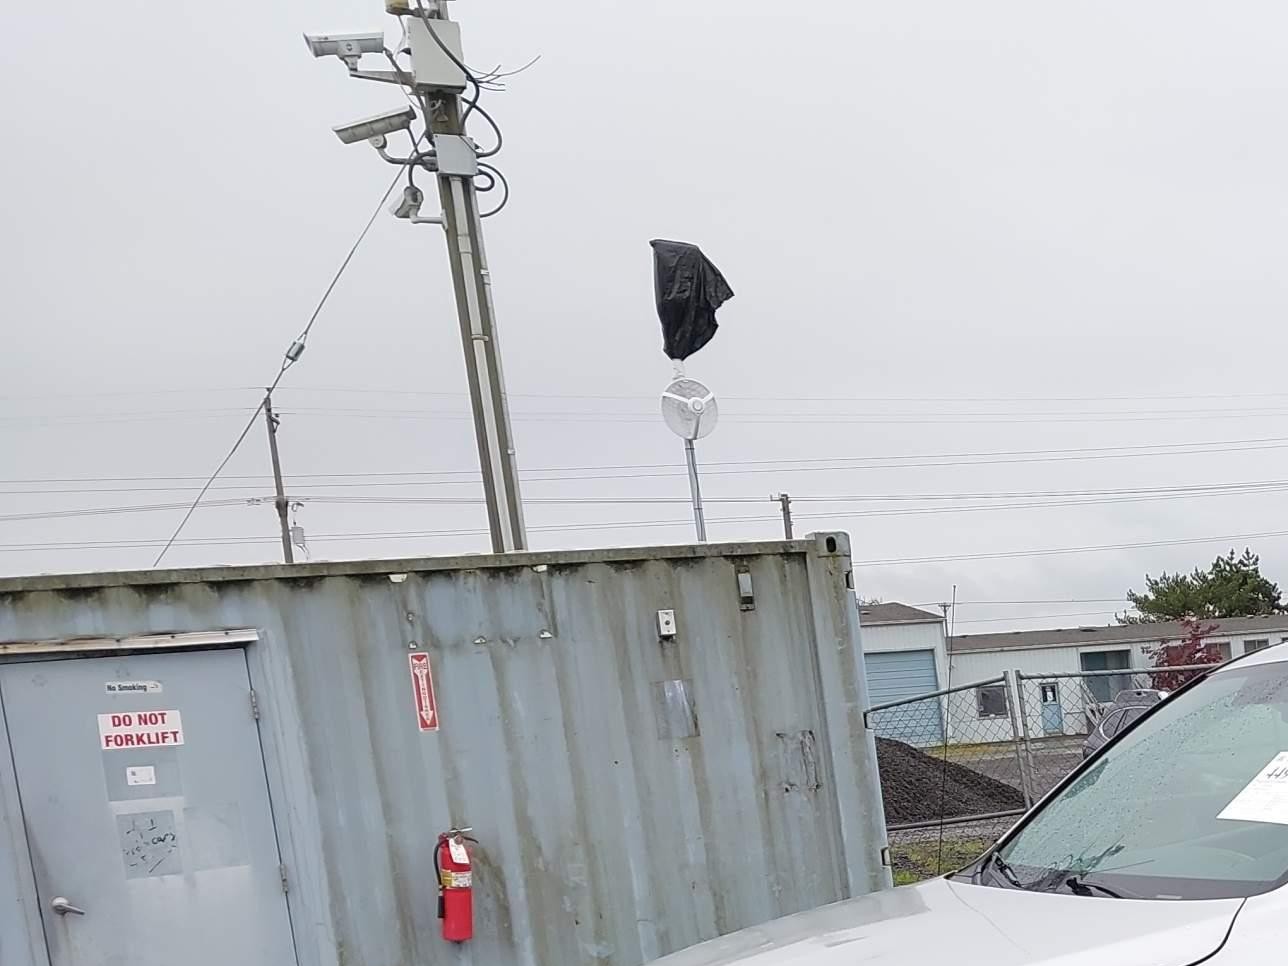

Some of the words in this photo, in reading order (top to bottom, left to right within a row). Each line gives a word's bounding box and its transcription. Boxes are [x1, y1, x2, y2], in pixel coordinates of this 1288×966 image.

[118, 683, 147, 692] Smoking
[111, 714, 132, 727] DO
[137, 712, 167, 726] NOT
[104, 731, 179, 747] FORKLIFT
